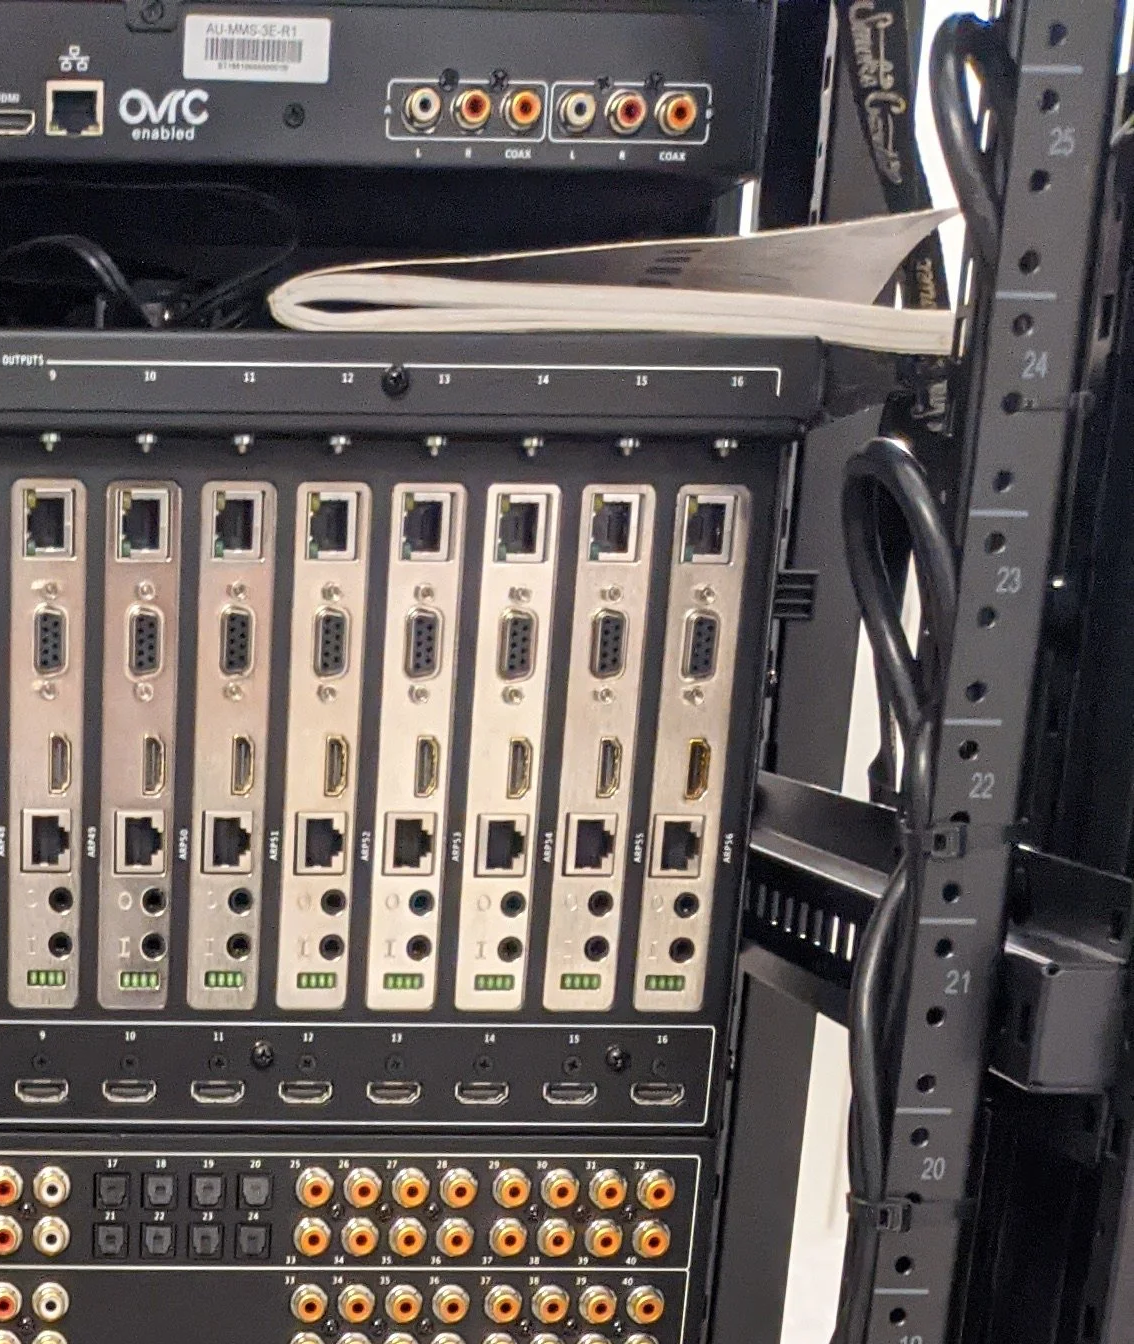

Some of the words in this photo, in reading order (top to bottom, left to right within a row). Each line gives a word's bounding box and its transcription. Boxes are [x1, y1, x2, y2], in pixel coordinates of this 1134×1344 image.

[206, 22, 297, 38] AU-MMS-3E-R1
[131, 127, 195, 142] enabled
[1050, 127, 1075, 156] 25
[504, 149, 532, 160] COAX
[658, 151, 686, 162] COAX
[1, 354, 44, 367] OUTPUTS
[1022, 350, 1047, 378] 24
[996, 567, 1021, 593] 23
[969, 772, 994, 798] 22
[360, 831, 371, 862] ARP52
[451, 831, 462, 863] ARP53
[543, 832, 554, 863] ARP54
[634, 832, 644, 863] ARP55
[724, 833, 734, 864] ARP56
[945, 970, 970, 994] 21
[39, 1030, 46, 1040] 9
[125, 1030, 137, 1042] 10
[213, 1031, 224, 1042] 11
[303, 1031, 314, 1043] 12
[391, 1032, 403, 1043] 13
[484, 1033, 496, 1044] 14
[569, 1034, 580, 1044] 15
[657, 1034, 669, 1044] 16
[921, 1157, 945, 1180] 20
